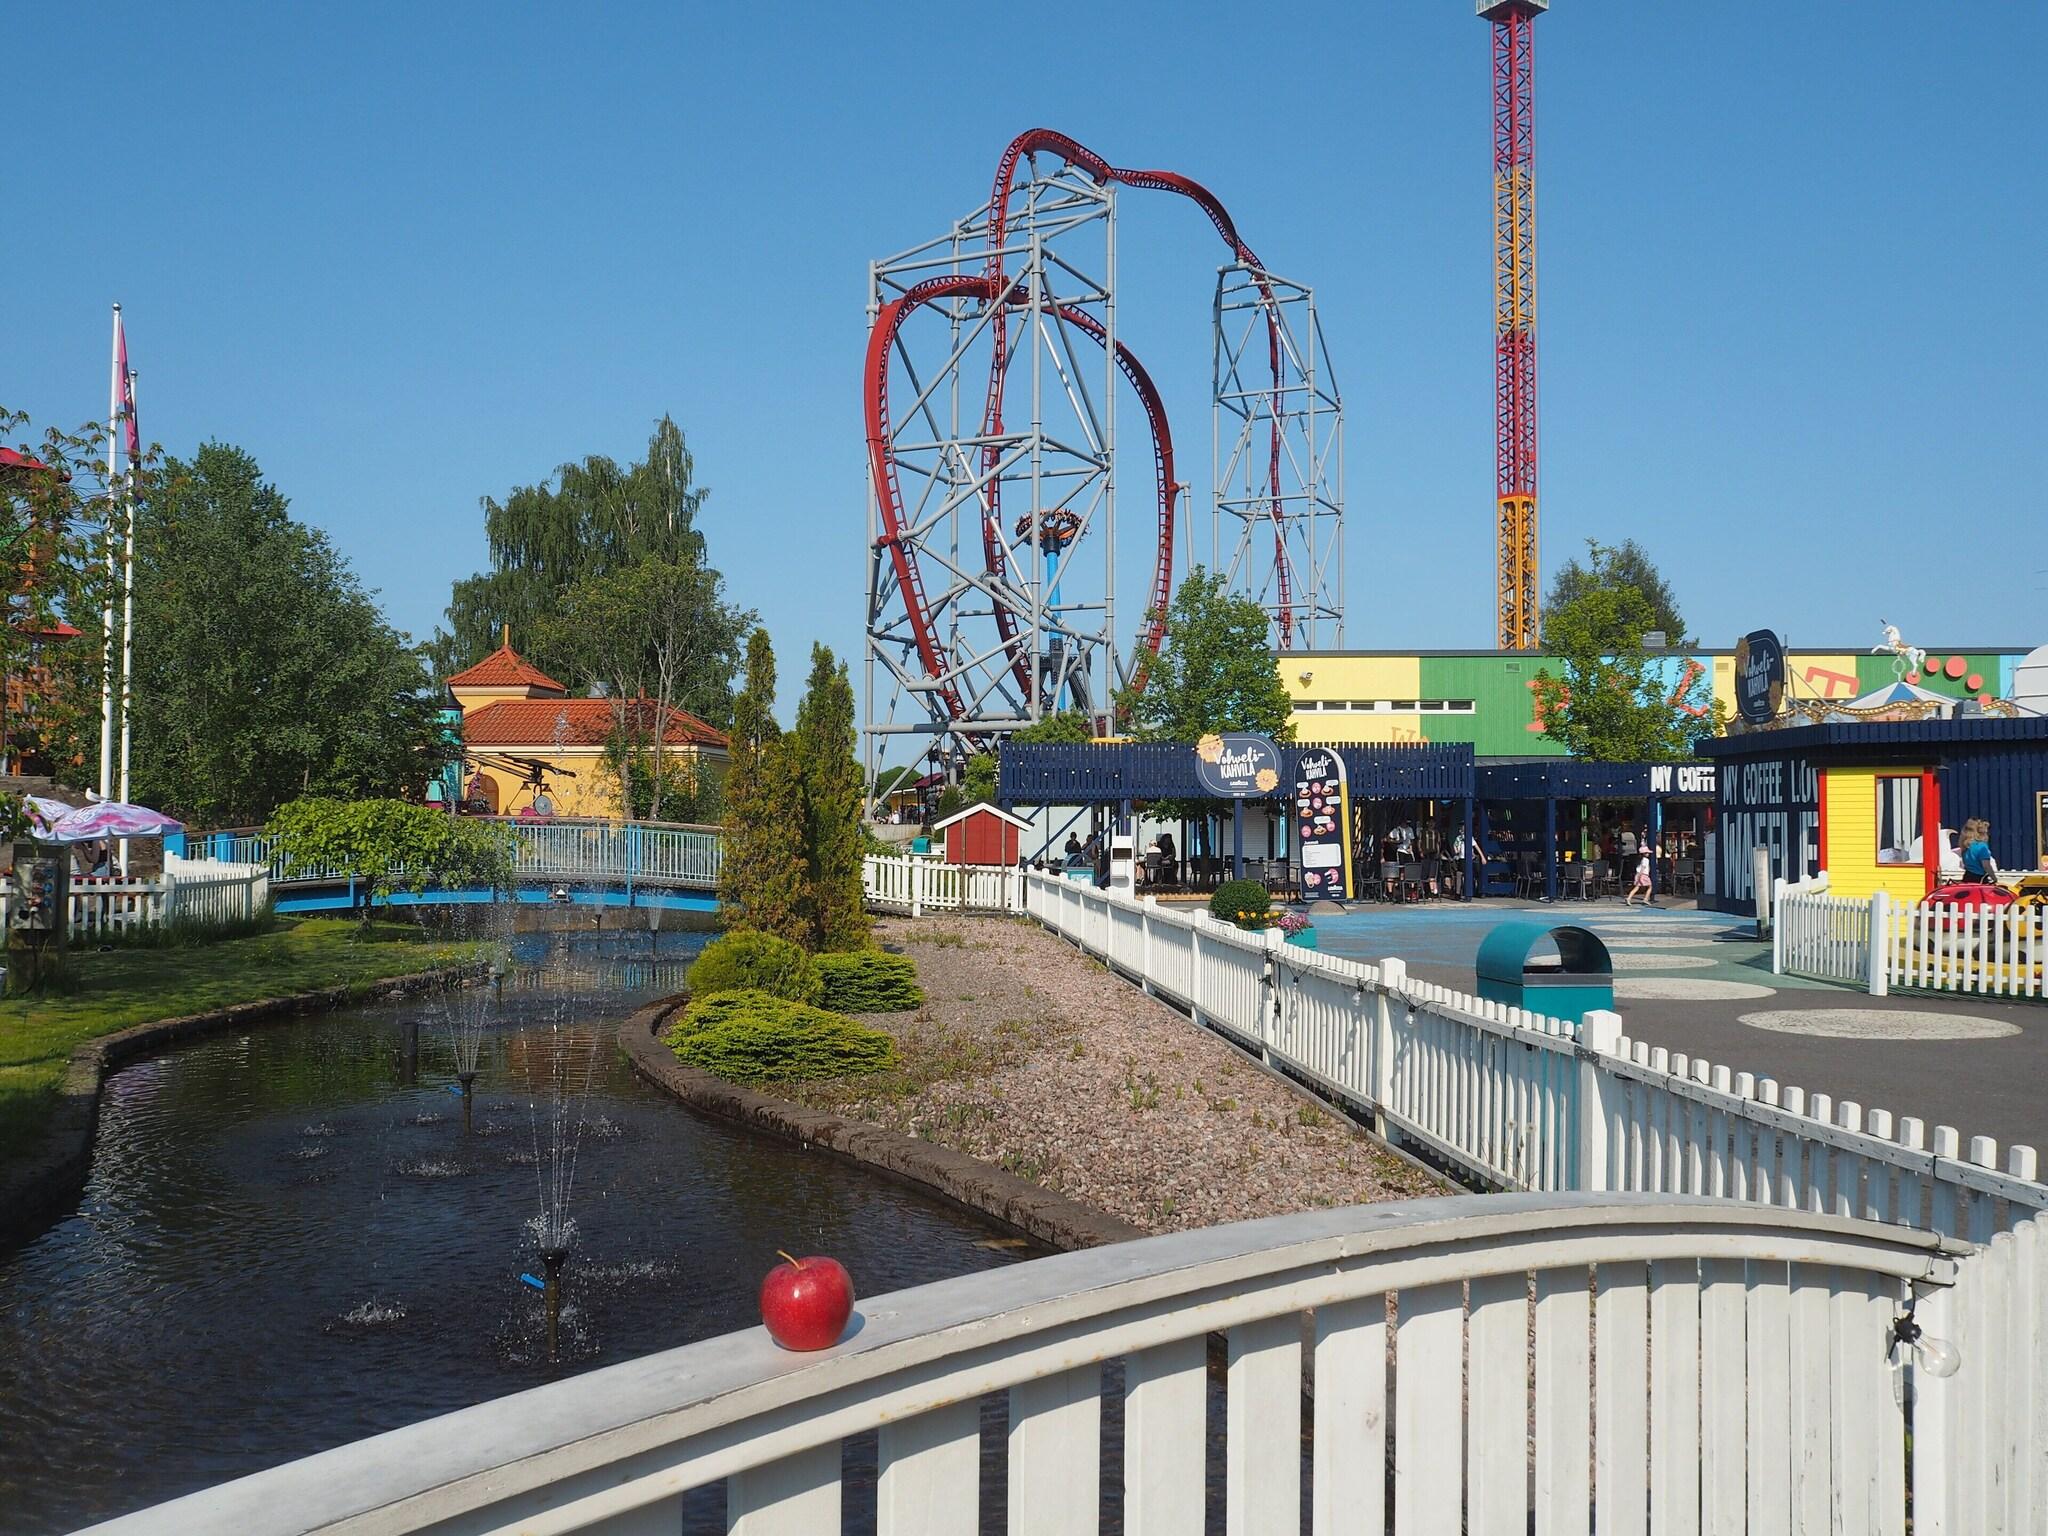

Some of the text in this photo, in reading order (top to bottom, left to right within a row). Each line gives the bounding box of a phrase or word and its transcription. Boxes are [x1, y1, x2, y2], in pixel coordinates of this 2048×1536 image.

[1220, 762, 1256, 779] KAHVILA
[1651, 765, 1672, 793] MY
[1723, 764, 1739, 806] MY
[1743, 760, 1783, 805] COFFEE
